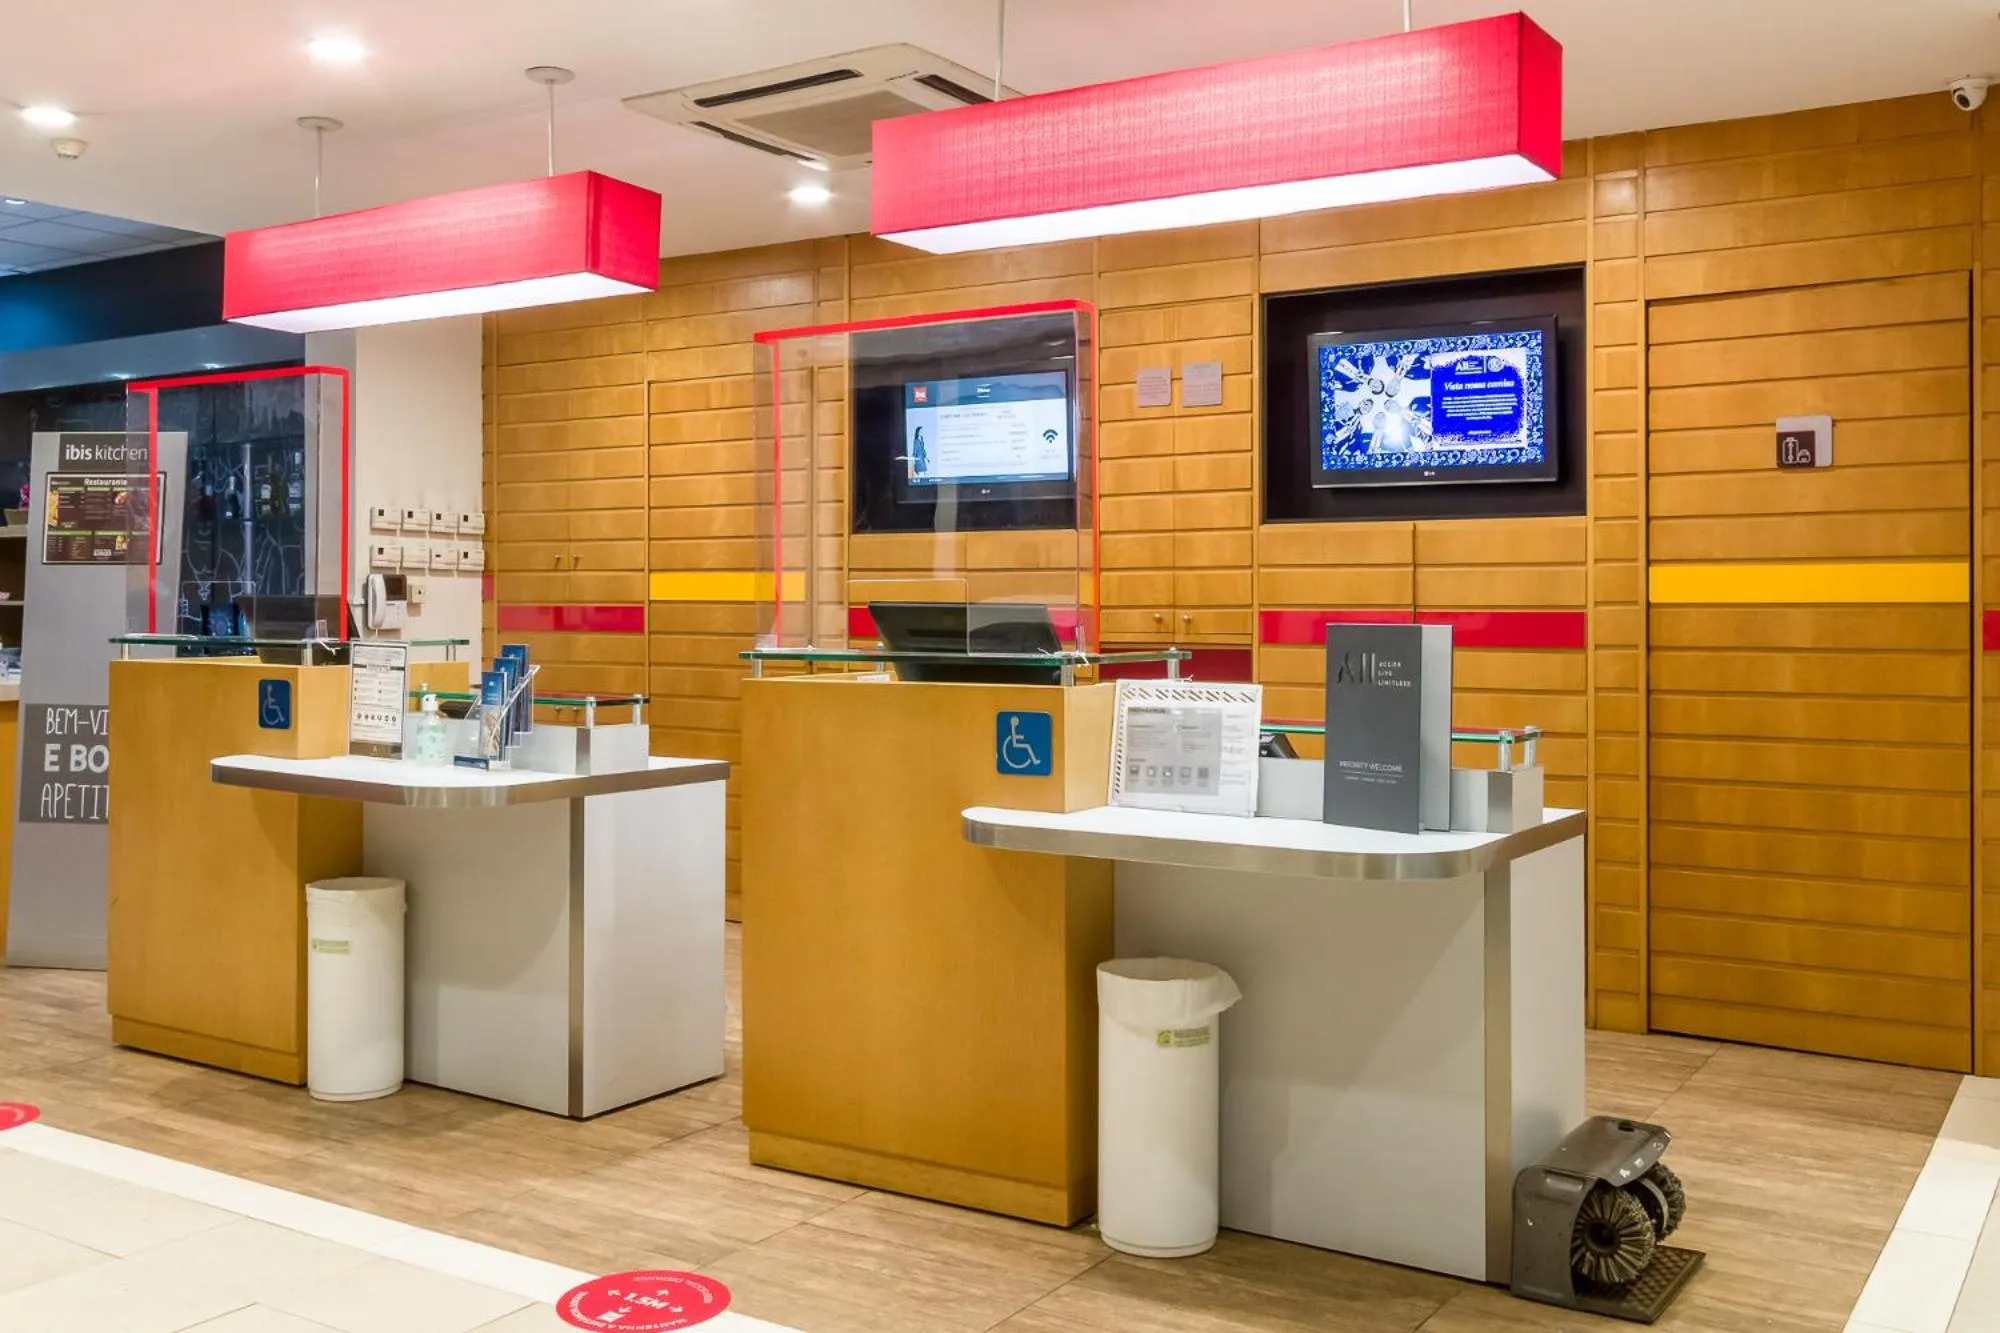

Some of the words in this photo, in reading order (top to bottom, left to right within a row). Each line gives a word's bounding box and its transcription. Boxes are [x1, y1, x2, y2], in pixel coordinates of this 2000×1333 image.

[65, 444, 92, 461] ibis
[95, 444, 148, 461] kitchen
[1378, 679, 1412, 687] LIMITLESS
[44, 743, 61, 772] E
[70, 744, 109, 774] BO
